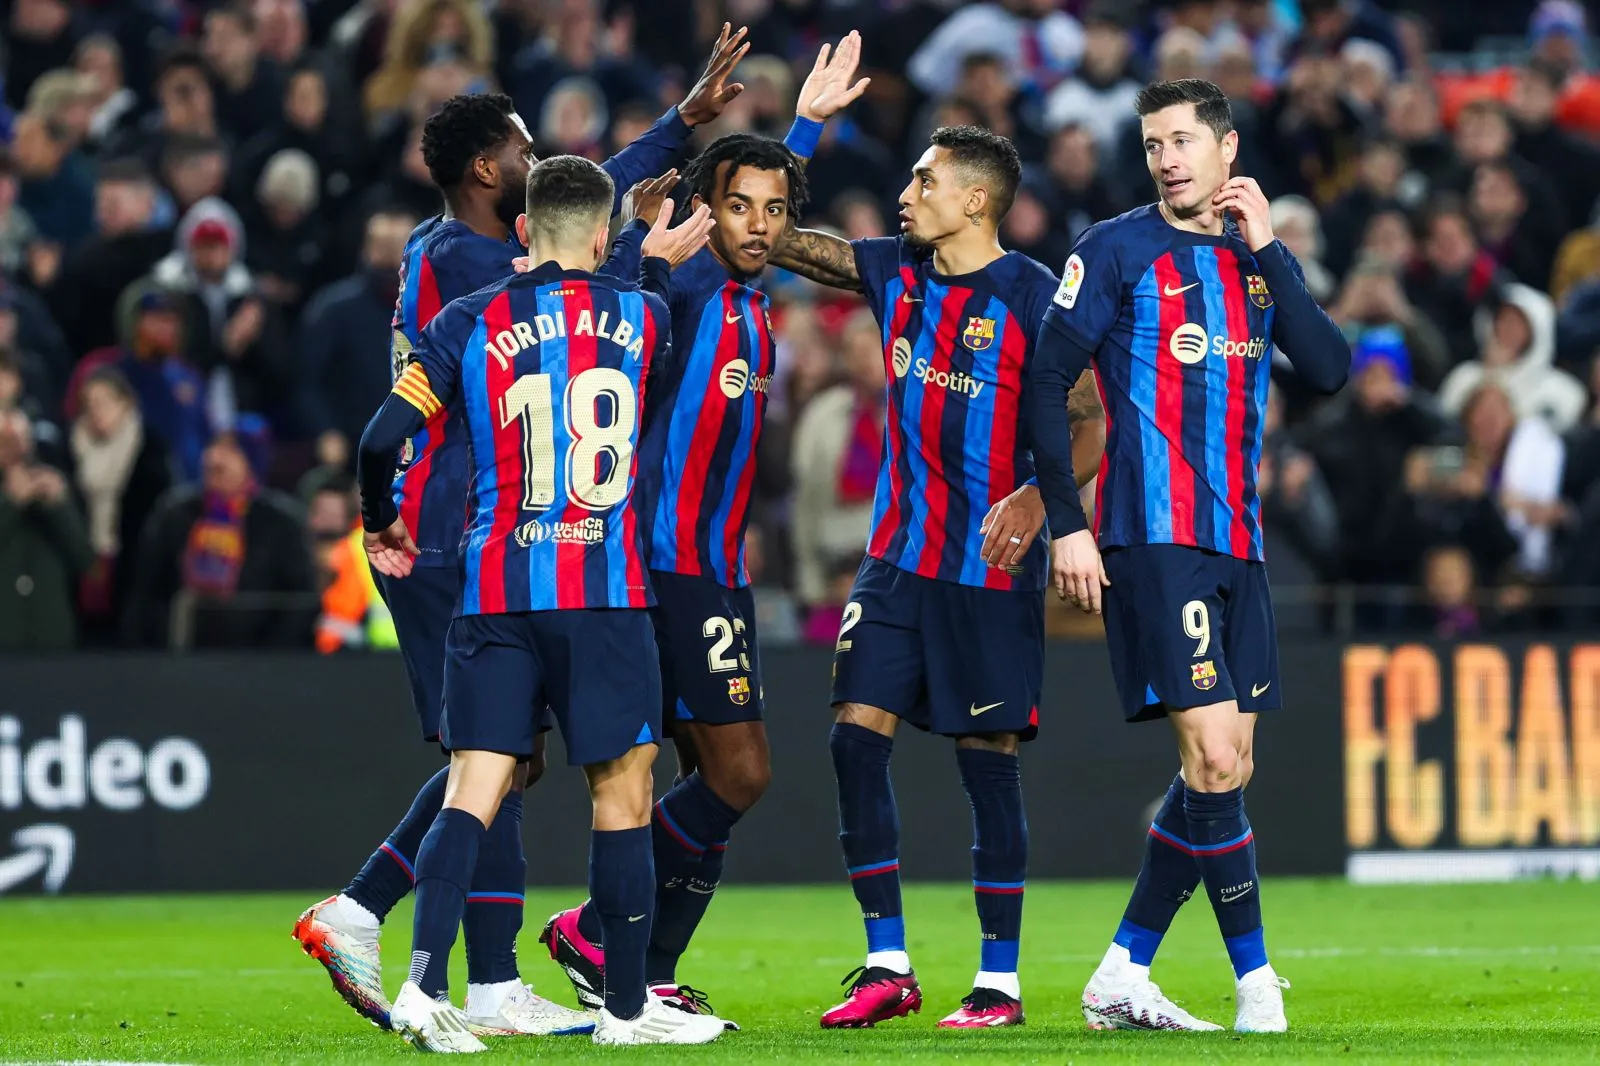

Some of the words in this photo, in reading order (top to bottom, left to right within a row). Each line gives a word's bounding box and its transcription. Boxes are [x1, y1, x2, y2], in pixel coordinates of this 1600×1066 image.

[484, 311, 566, 371] JORDI
[574, 309, 644, 362] ALBA
[1212, 335, 1268, 361] Spotify
[913, 357, 984, 399] Spotify
[499, 368, 636, 512] 18
[1182, 600, 1211, 657] 9
[0, 713, 210, 810] ideo
[1341, 643, 1443, 848] FC
[1220, 880, 1253, 894] CULERS
